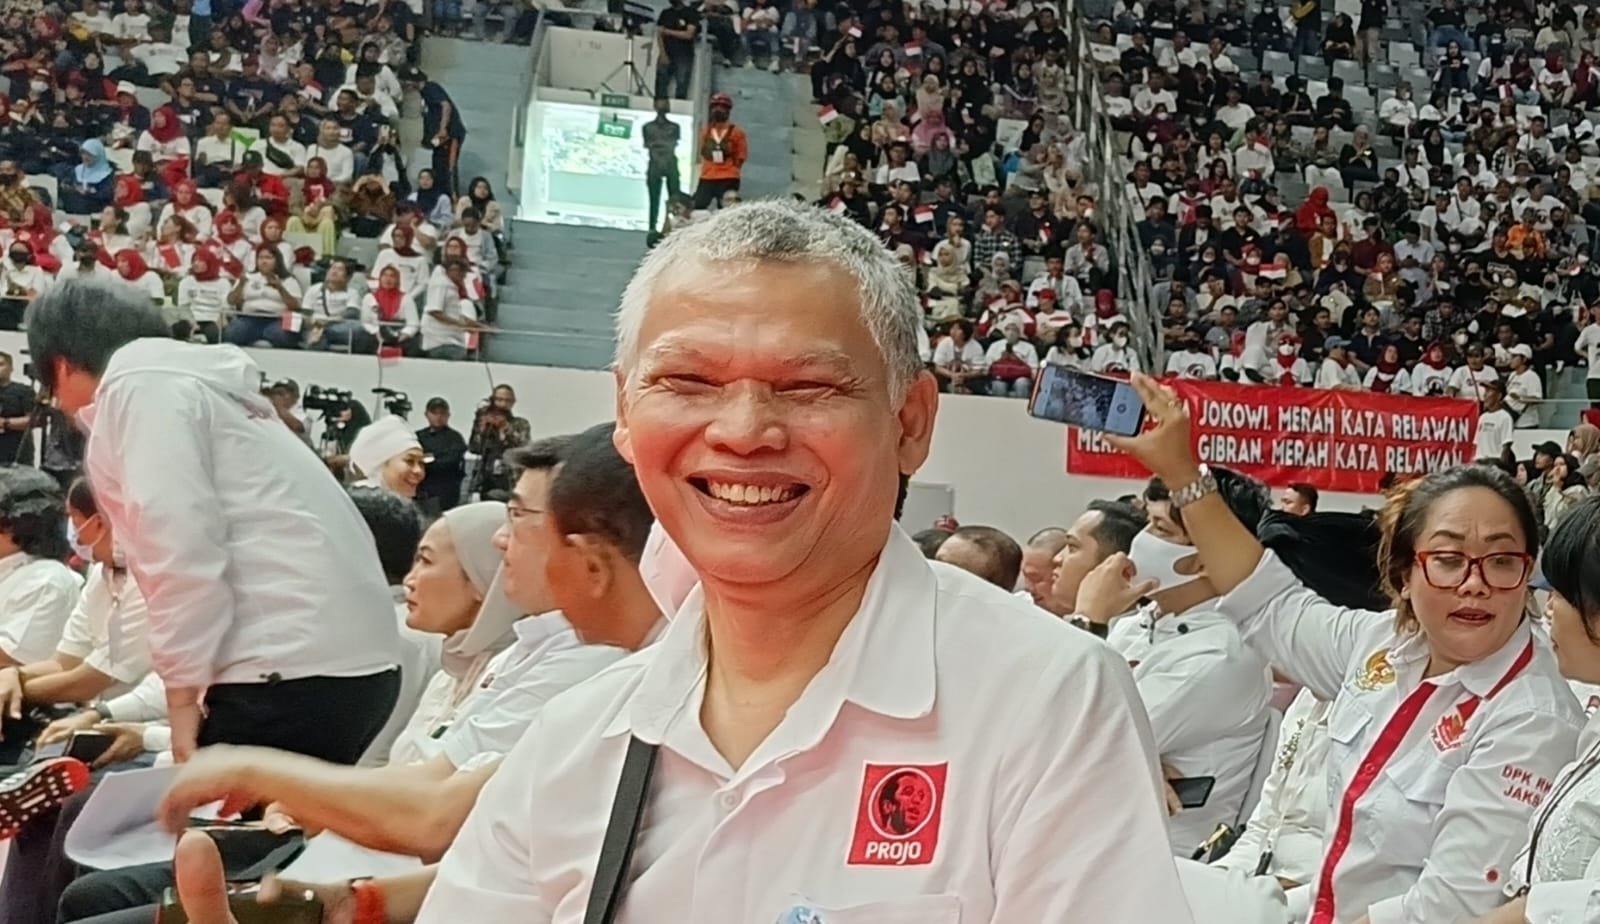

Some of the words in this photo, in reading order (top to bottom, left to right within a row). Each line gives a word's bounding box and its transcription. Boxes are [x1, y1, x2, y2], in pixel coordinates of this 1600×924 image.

[603, 123, 626, 136] EXIT
[1199, 400, 1272, 431] JOKOWI.
[1278, 406, 1335, 434] MERAH
[1341, 409, 1386, 438] KATA
[1392, 414, 1470, 442] RELAWAN
[1077, 427, 1130, 454] MER
[1198, 434, 1265, 464] GIBRAN.
[1271, 439, 1329, 468] MERAH
[1335, 441, 1380, 470] KATA
[1502, 764, 1534, 786] DPK
[1503, 785, 1543, 808] JAKS
[865, 841, 922, 865] PROJO
